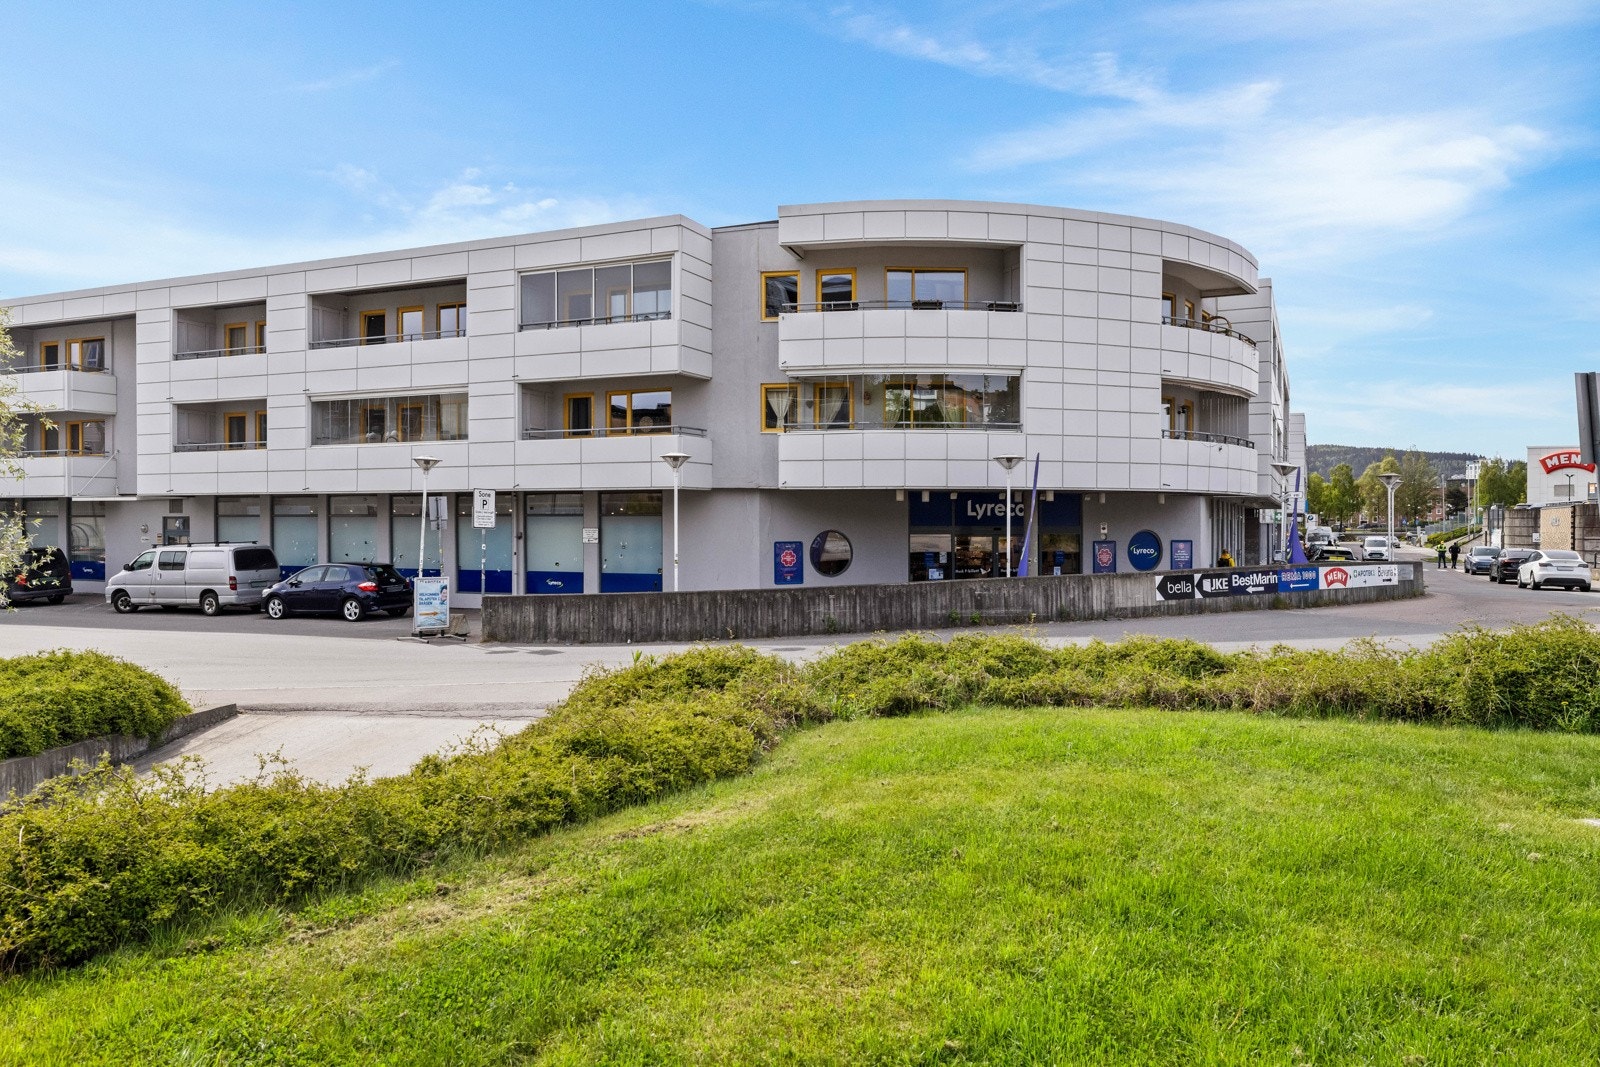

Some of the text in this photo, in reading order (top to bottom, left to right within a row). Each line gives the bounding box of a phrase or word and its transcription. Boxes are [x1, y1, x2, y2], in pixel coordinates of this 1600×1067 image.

[1545, 454, 1588, 468] MEN
[483, 500, 488, 509] P
[967, 500, 1024, 520] Lyreco
[1133, 547, 1155, 555] Lyreco
[1232, 573, 1278, 586] BestMarin
[1281, 570, 1317, 581] REMA 1000
[1326, 570, 1347, 583] MENY
[1167, 581, 1192, 594] bella
[1211, 578, 1229, 590] JKE
